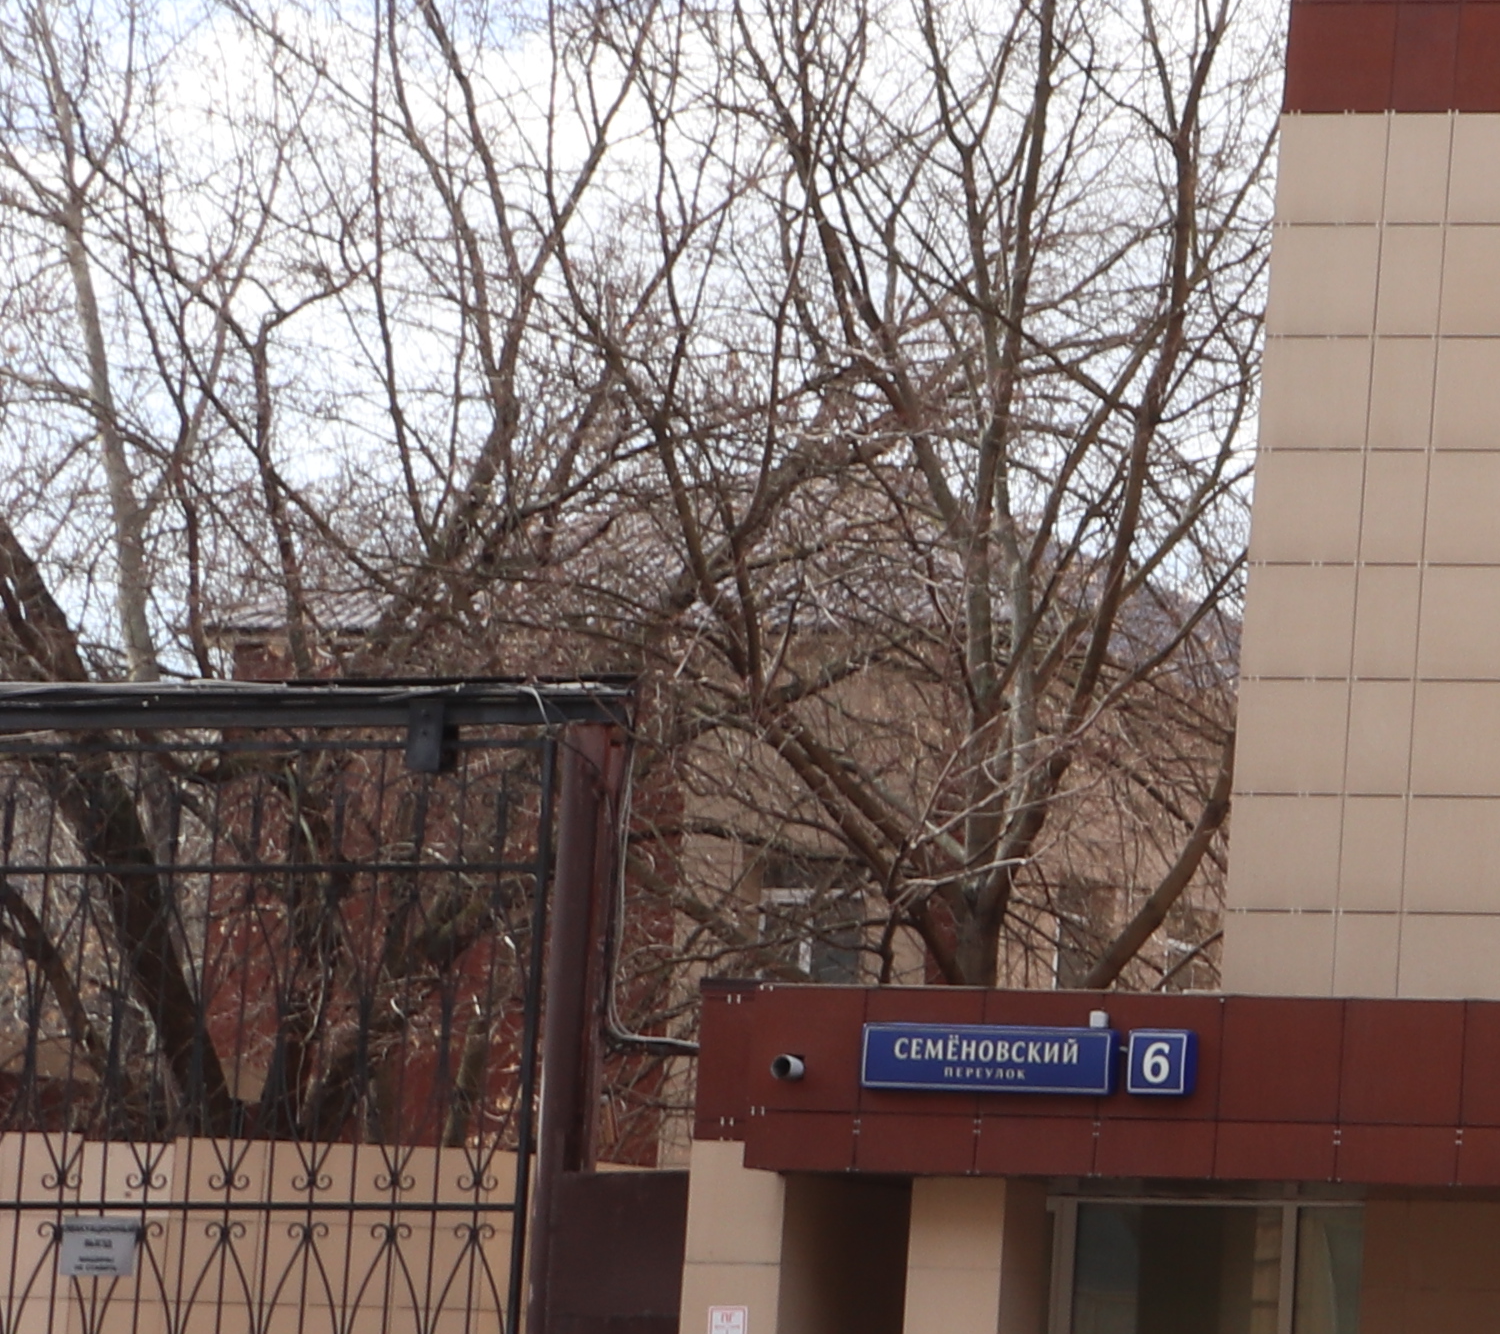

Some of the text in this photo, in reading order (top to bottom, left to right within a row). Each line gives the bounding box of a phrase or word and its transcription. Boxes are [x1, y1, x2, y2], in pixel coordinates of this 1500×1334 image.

[893, 1034, 1079, 1065] СЕМЁНОВСКИЙ
[1142, 1042, 1170, 1084] 6
[943, 1067, 1026, 1080] ПЕРЕУЛОК
